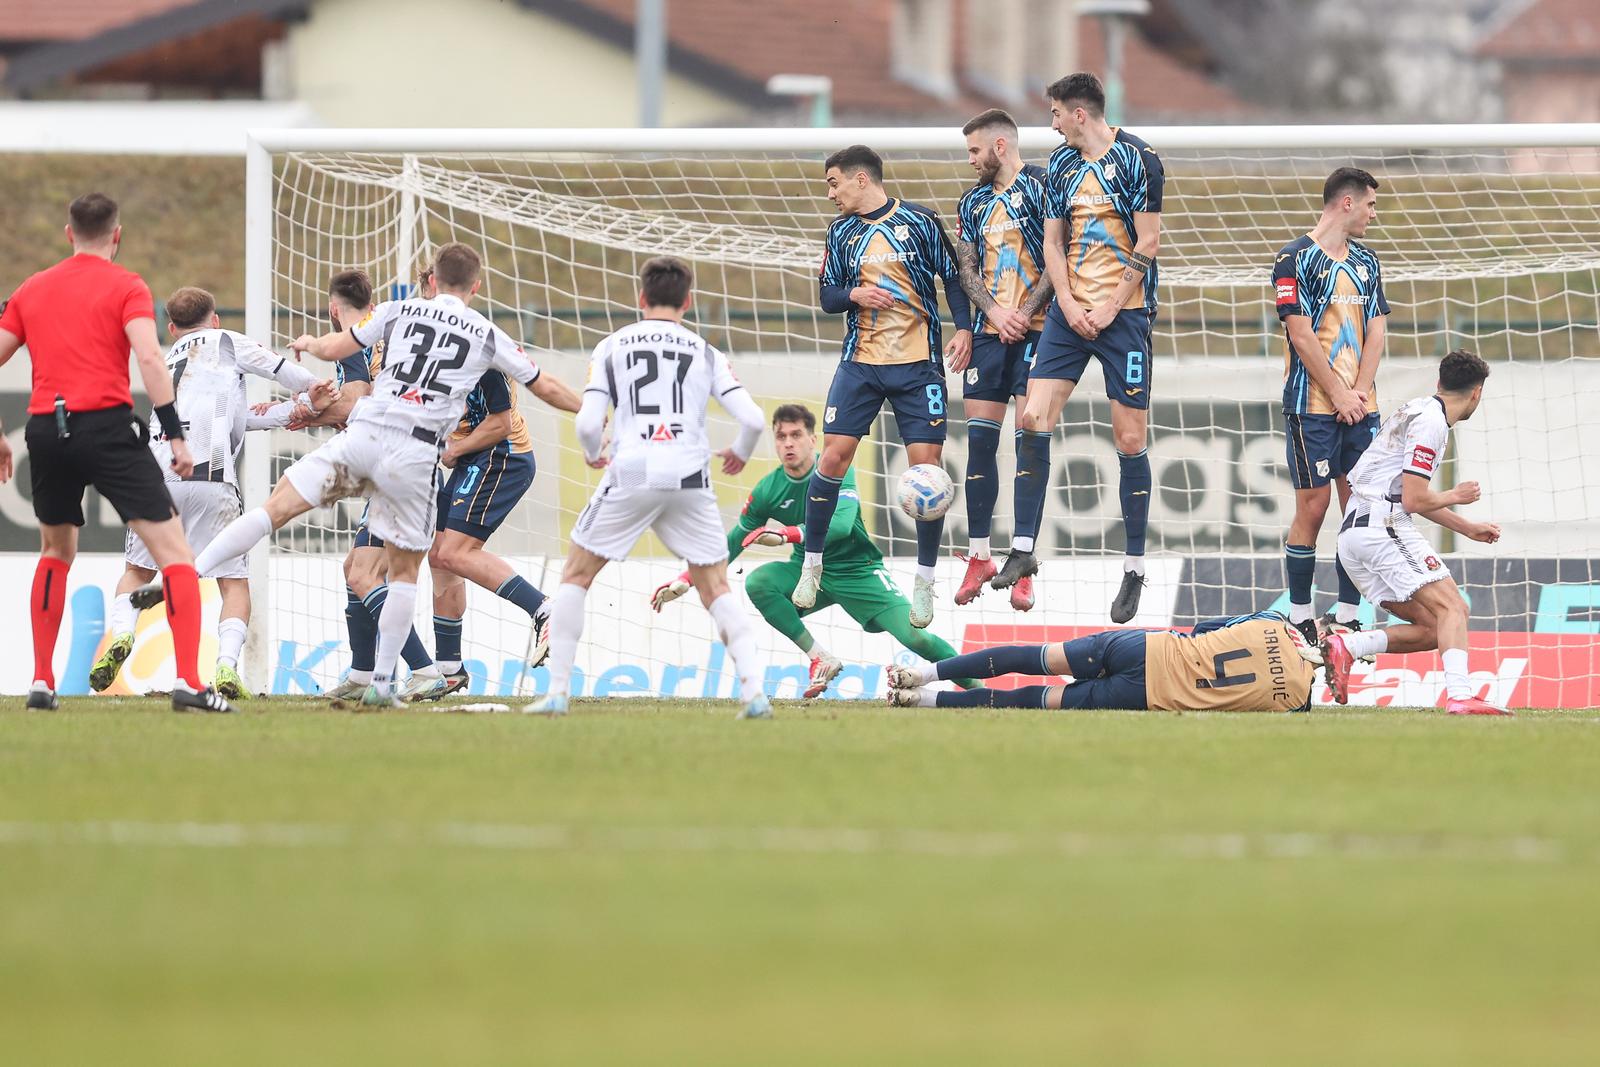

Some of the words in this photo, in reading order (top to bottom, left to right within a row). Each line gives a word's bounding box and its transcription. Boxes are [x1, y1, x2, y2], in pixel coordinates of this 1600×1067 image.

[1070, 193, 1120, 206] FAVBET
[983, 217, 1029, 235] FAVBET
[860, 251, 916, 265] FAVBET
[1330, 294, 1370, 305] FAVBET
[401, 304, 485, 339] HALILOVIĆ
[167, 336, 206, 361] AZITI
[619, 332, 699, 350] SIKOŠEK
[393, 322, 471, 396] 32
[1126, 351, 1143, 383] 6
[627, 350, 693, 416] 27
[926, 384, 943, 415] 8
[641, 423, 683, 440] JAF
[1196, 648, 1256, 688] 4
[1264, 629, 1290, 701] JANKOVIĆ
